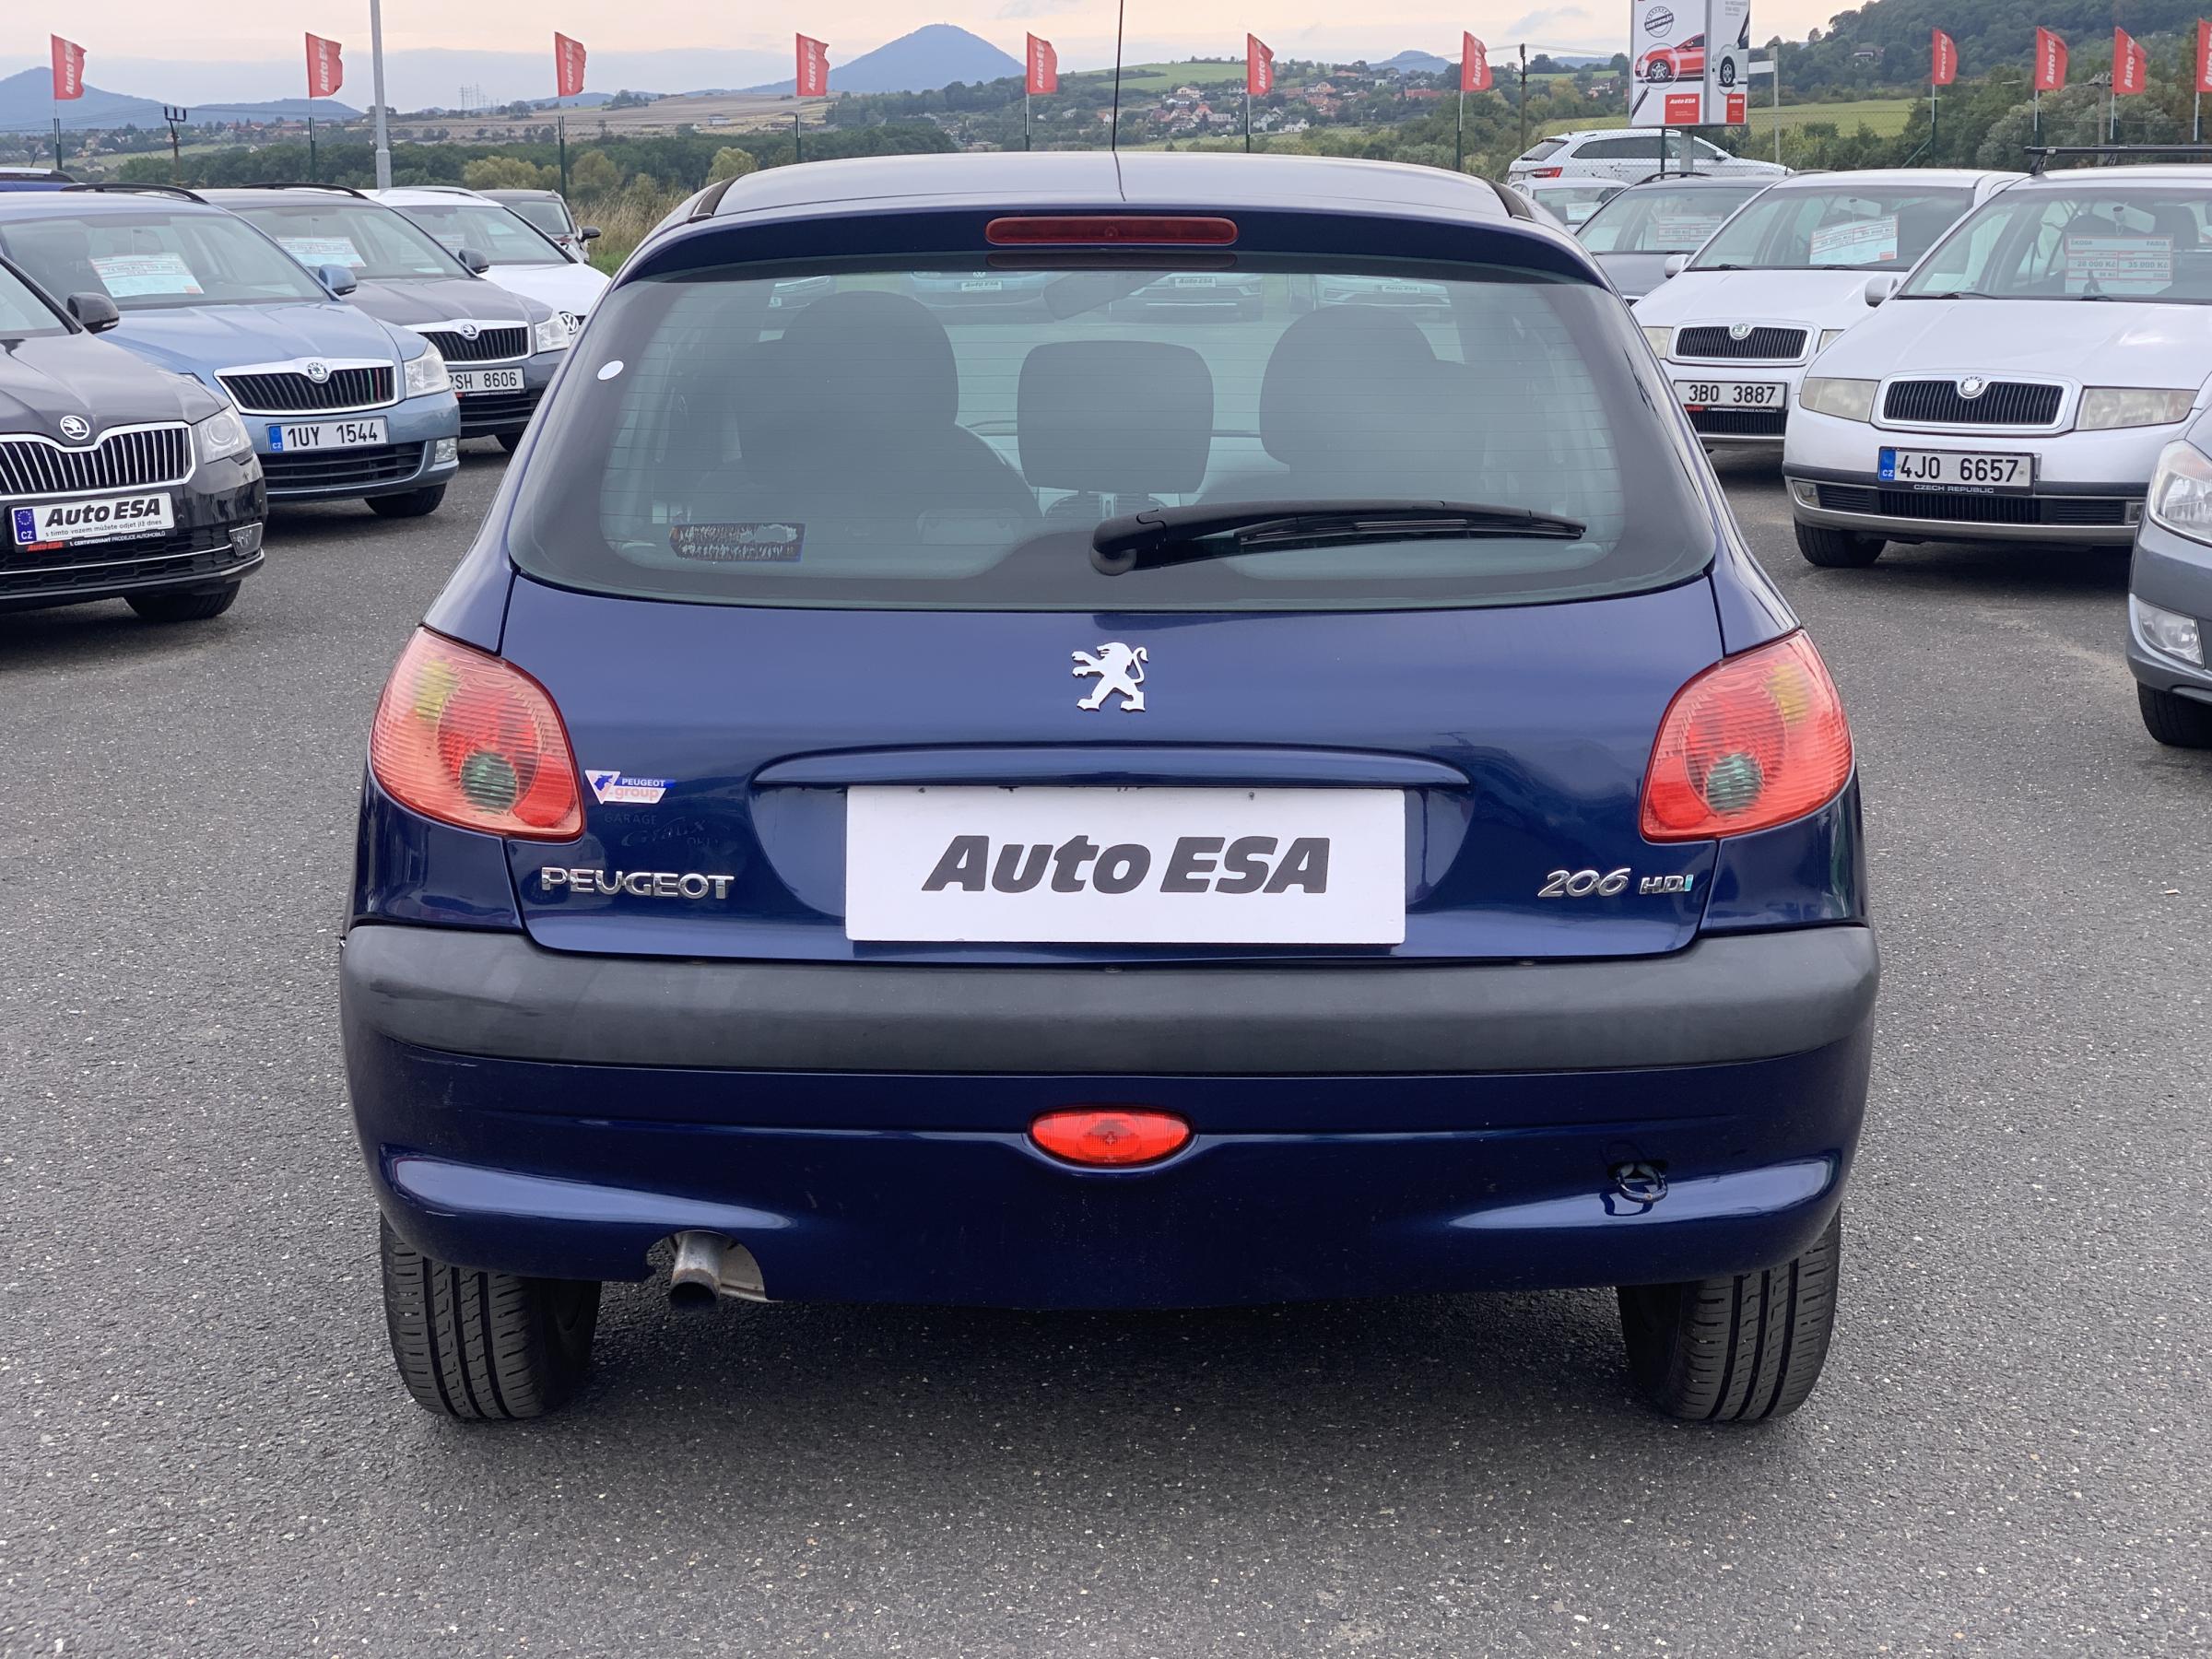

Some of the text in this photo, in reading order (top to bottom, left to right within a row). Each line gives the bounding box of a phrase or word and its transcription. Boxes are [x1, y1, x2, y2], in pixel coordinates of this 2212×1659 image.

[65, 63, 75, 94] Auto
[319, 60, 329, 92] Auto
[807, 61, 817, 90] Auto
[1258, 60, 1266, 88] Auto
[2046, 54, 2056, 84] Auto
[2124, 56, 2136, 88] Auto
[484, 371, 517, 388] 8606
[1733, 385, 1776, 404] 3887
[288, 422, 378, 447] 1UY 1544
[1882, 469, 1894, 477] CZ
[1959, 457, 2019, 482] 6657
[1947, 486, 1994, 494] REPUBLIC
[45, 498, 161, 528] Auto ESA
[21, 530, 33, 539] CZ
[71, 526, 92, 535] vozem
[119, 520, 136, 529] odjet
[147, 518, 162, 526] dnes
[621, 778, 666, 787] PEUGEOT
[604, 813, 657, 824] GARAGE
[922, 834, 1331, 894] Auto ESA
[541, 867, 735, 900] PEUGEOT
[1536, 867, 1631, 898] 206
